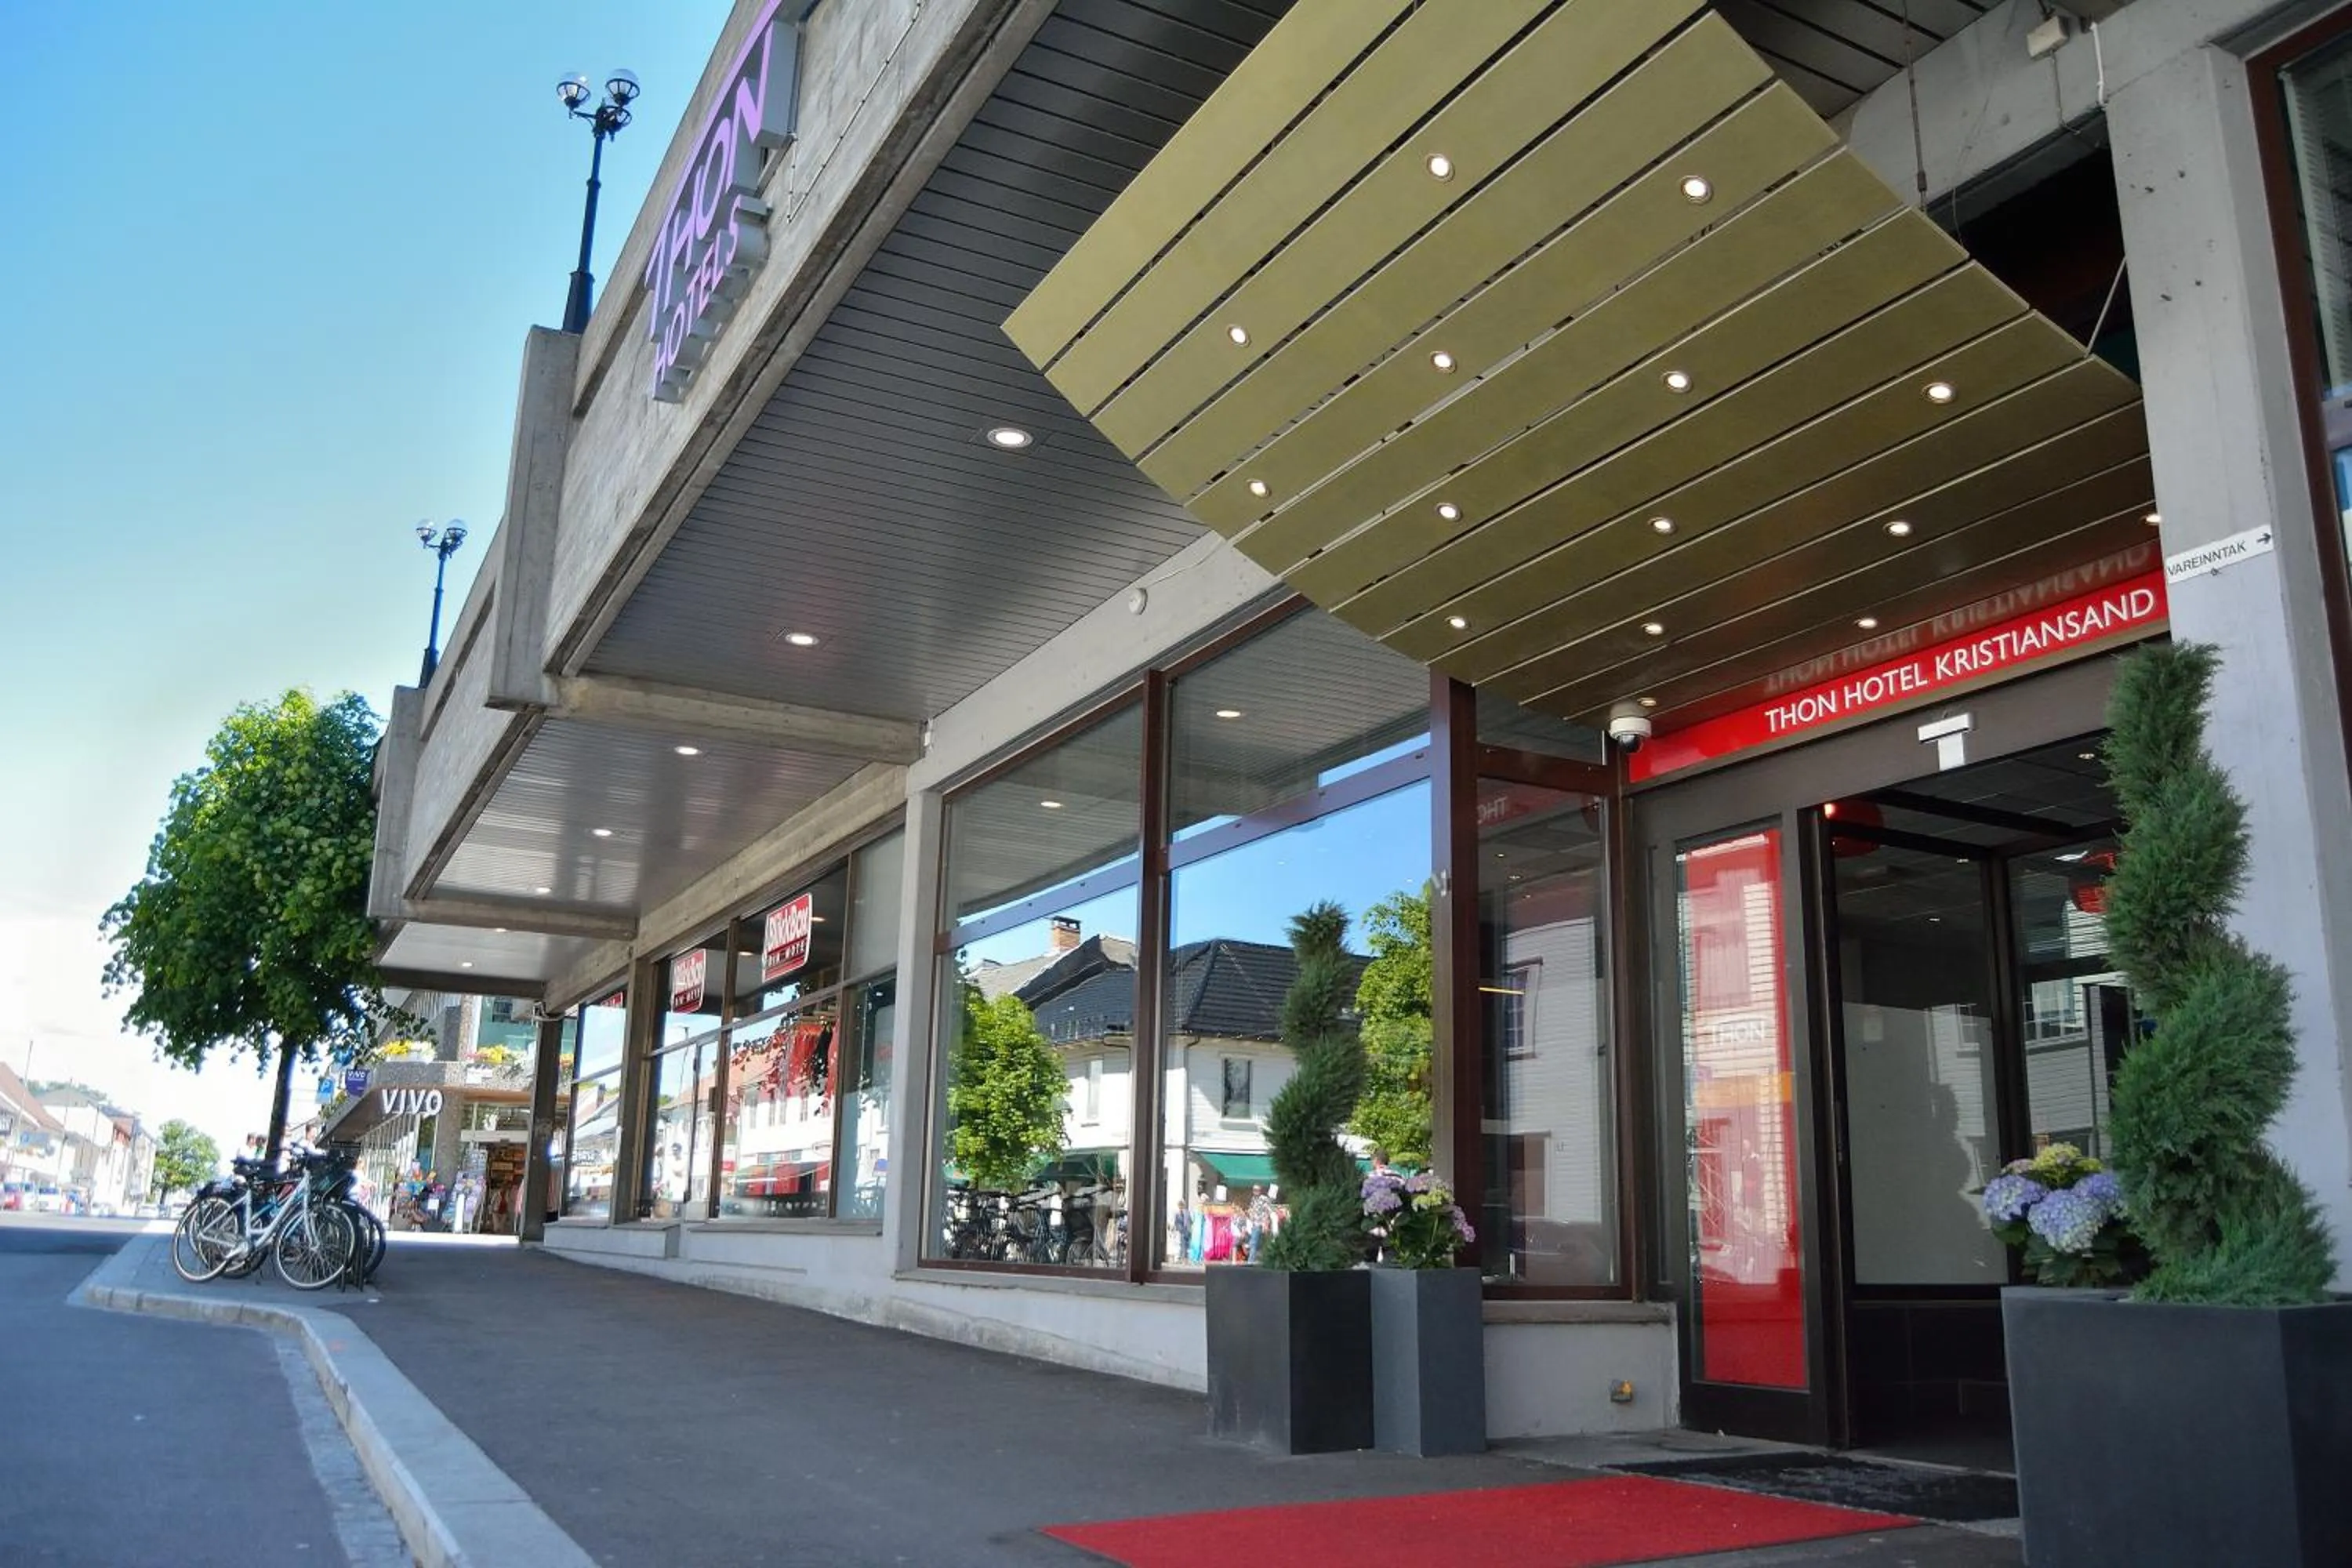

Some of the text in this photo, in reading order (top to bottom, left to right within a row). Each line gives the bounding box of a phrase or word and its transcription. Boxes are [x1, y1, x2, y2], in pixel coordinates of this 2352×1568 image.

[645, 0, 782, 339] THON
[652, 194, 742, 397] HOTELS
[2166, 540, 2247, 576] VAREINNTAK
[1764, 588, 2155, 733] THON HOTEL KRISTIANSAND
[347, 1070, 366, 1079] VIVO
[382, 1087, 444, 1117] VIVO
